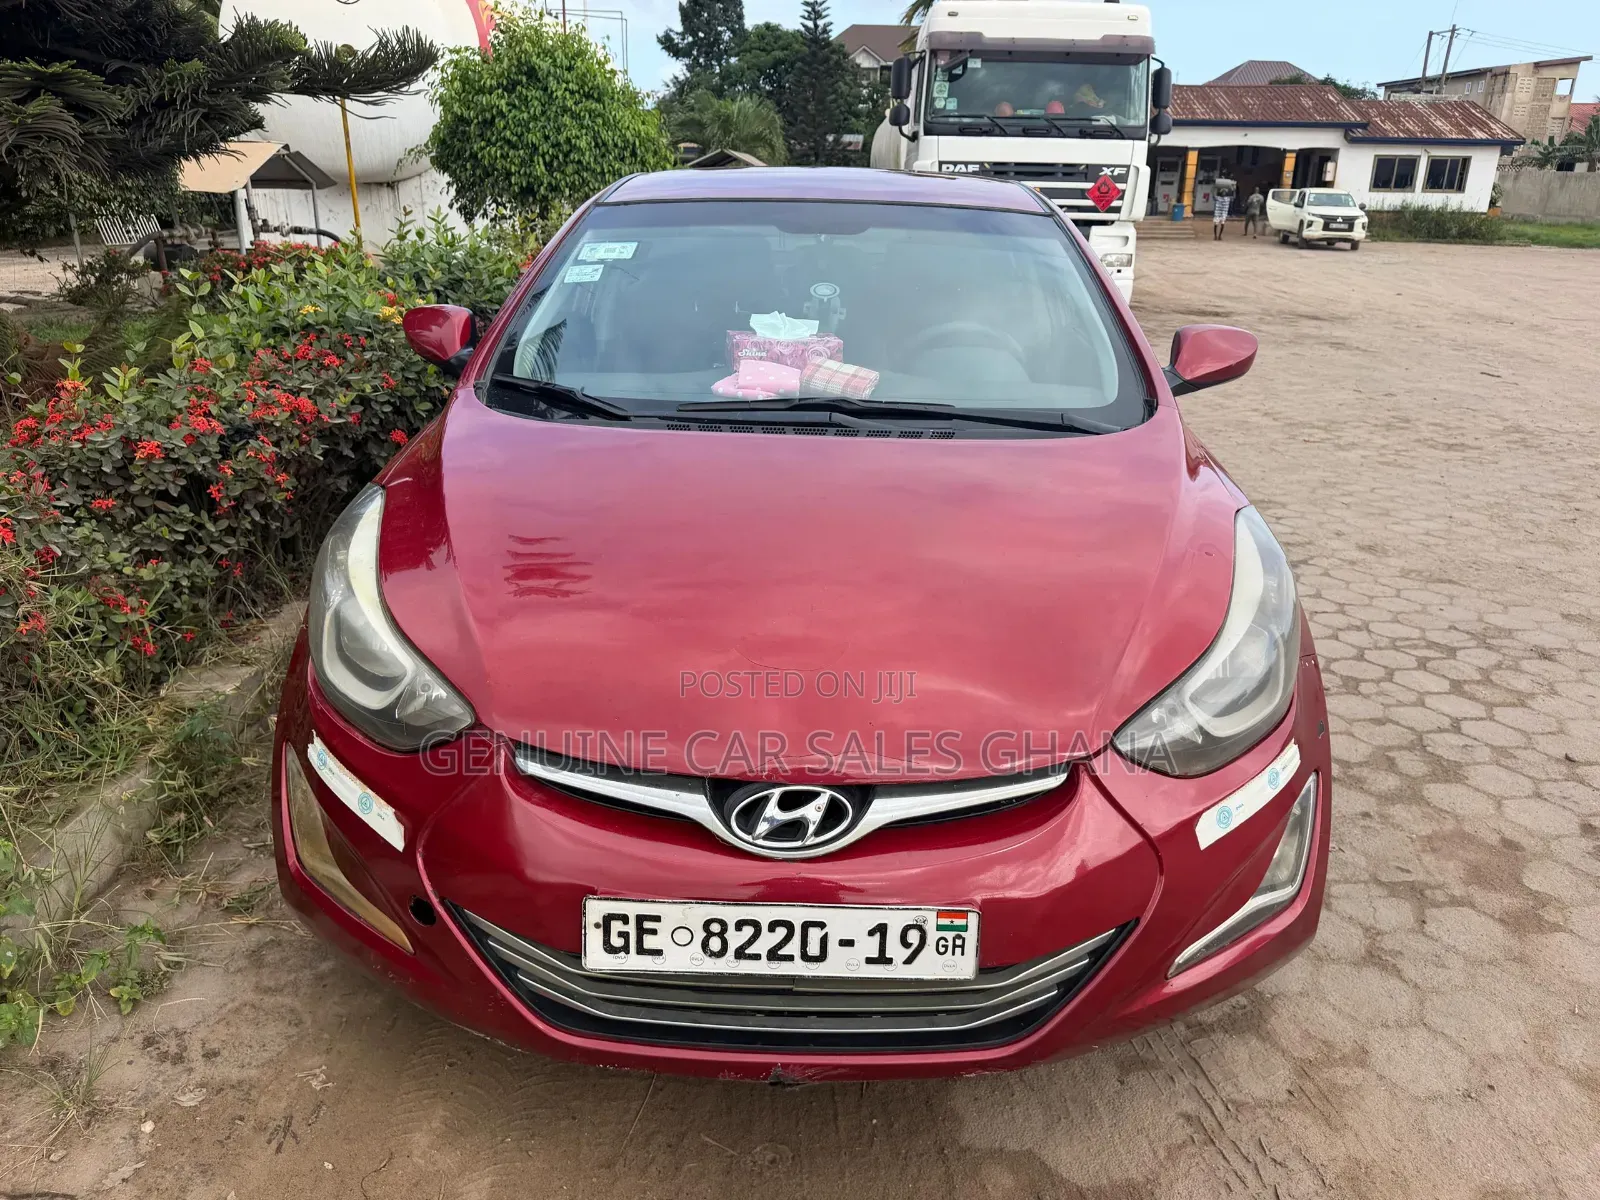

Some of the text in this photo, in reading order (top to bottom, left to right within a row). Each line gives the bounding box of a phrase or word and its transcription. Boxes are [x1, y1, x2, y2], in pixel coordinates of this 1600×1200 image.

[941, 163, 980, 173] DAF
[1099, 166, 1127, 176] XF
[602, 912, 664, 957] GE
